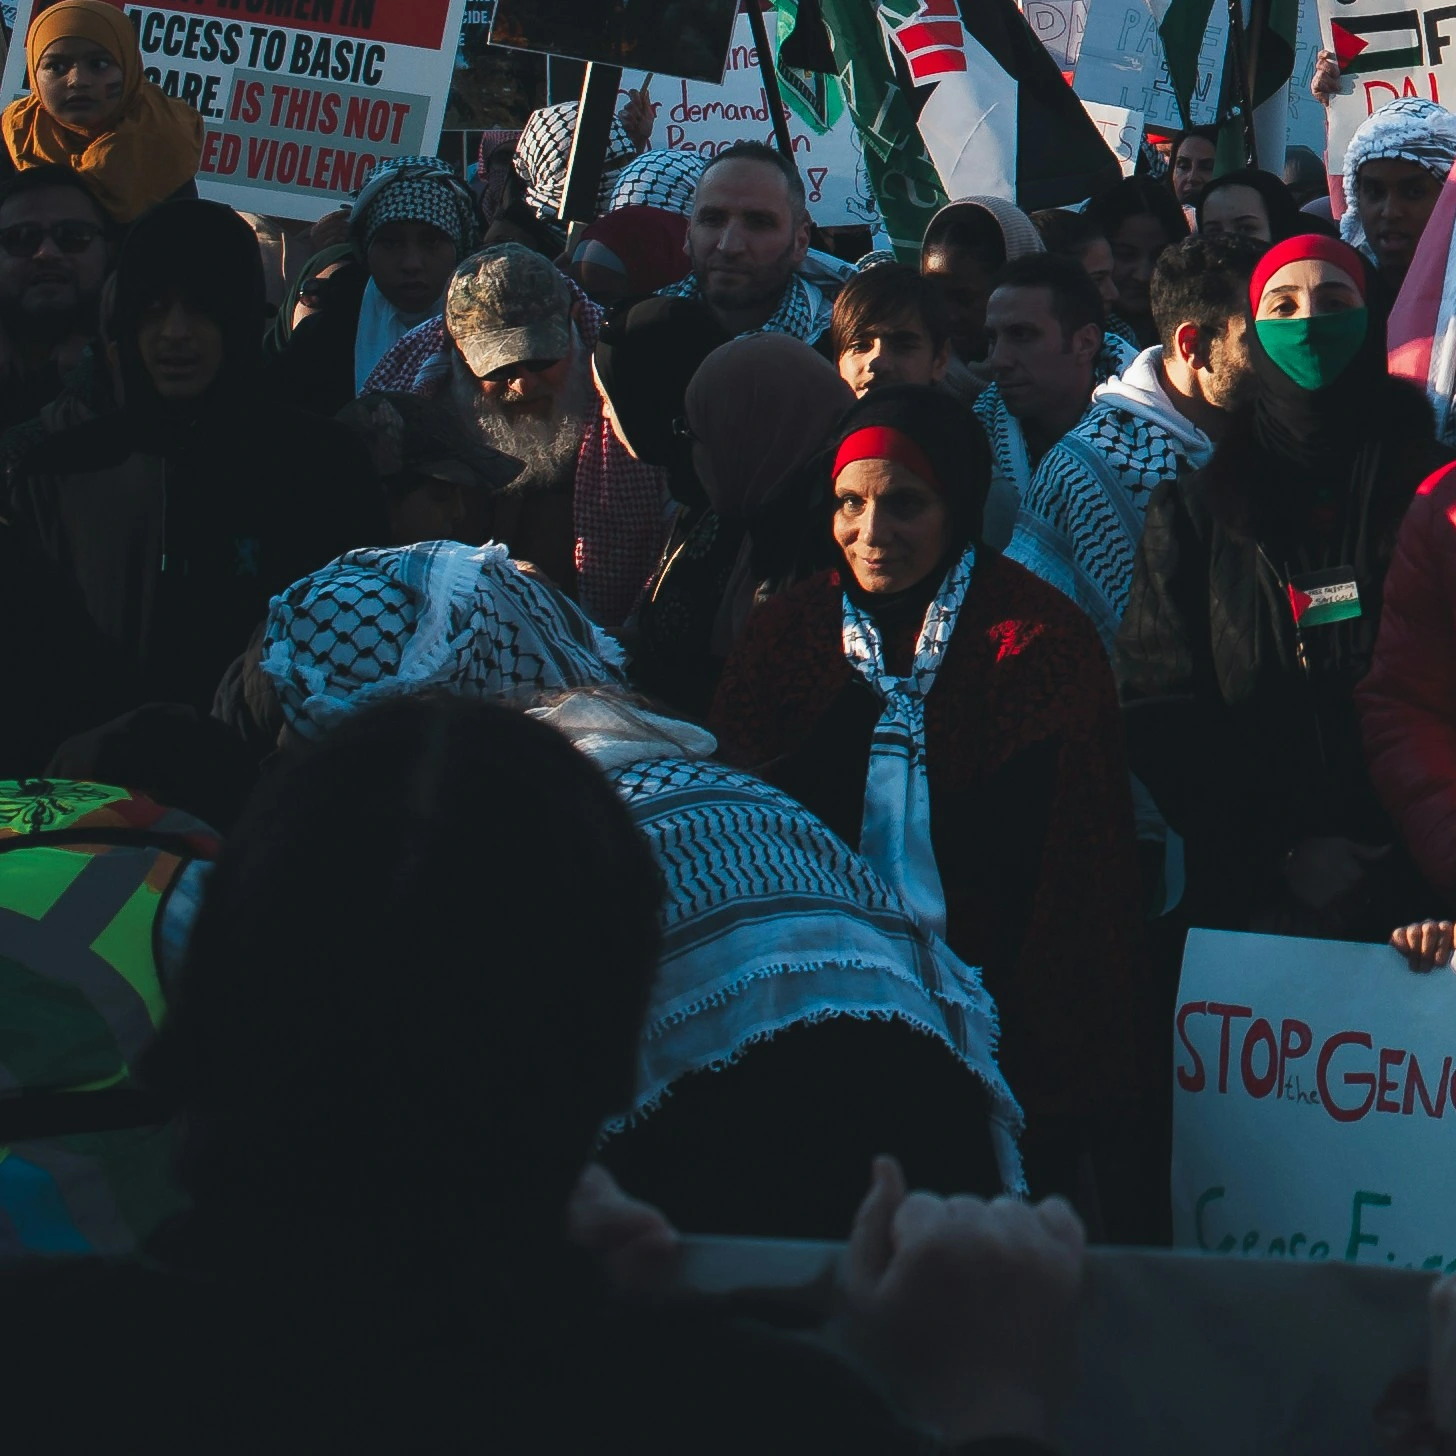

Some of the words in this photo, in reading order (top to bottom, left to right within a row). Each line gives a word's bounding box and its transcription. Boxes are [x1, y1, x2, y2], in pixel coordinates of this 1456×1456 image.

[246, 26, 291, 74] TO
[289, 38, 387, 88] BASIC
[229, 78, 266, 124] IS
[269, 83, 342, 136] THIS
[343, 94, 412, 146] NOT
[247, 136, 390, 194] VIOLENC
[1174, 1000, 1313, 1100] STOP
[1283, 1074, 1321, 1105] the
